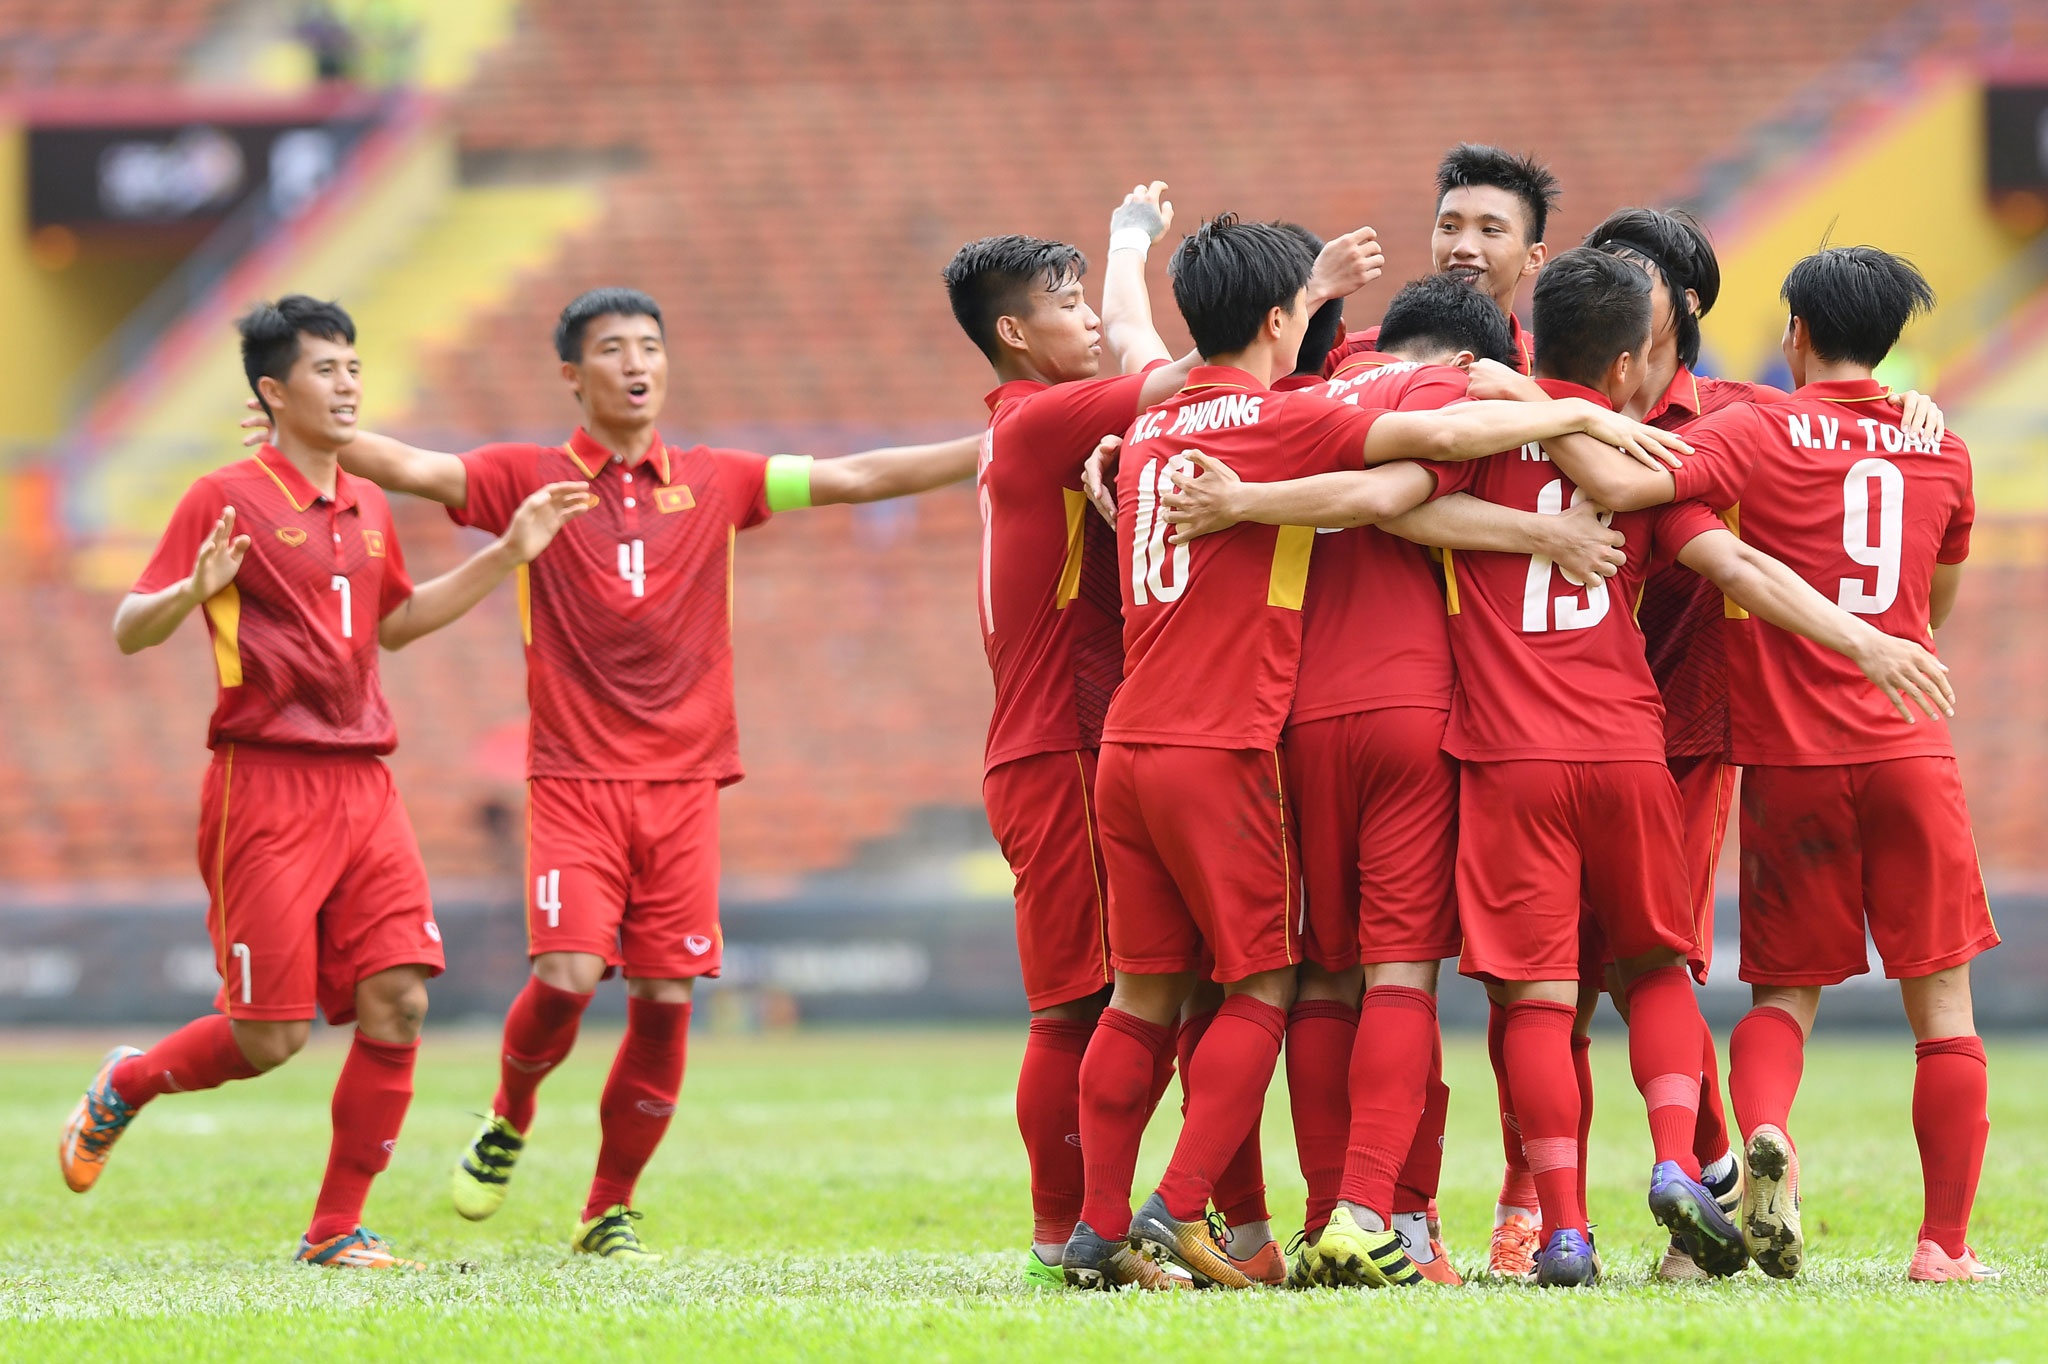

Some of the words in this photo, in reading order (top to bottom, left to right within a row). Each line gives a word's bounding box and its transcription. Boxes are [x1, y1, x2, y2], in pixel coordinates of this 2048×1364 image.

[1166, 394, 1264, 436] PHUONG
[1788, 413, 1850, 450] N.V.
[1132, 451, 1195, 606] 10
[1838, 458, 1904, 614] 9
[617, 539, 646, 597] 4
[331, 574, 352, 638] 7
[536, 869, 562, 928] 4
[232, 943, 251, 1004] 7
